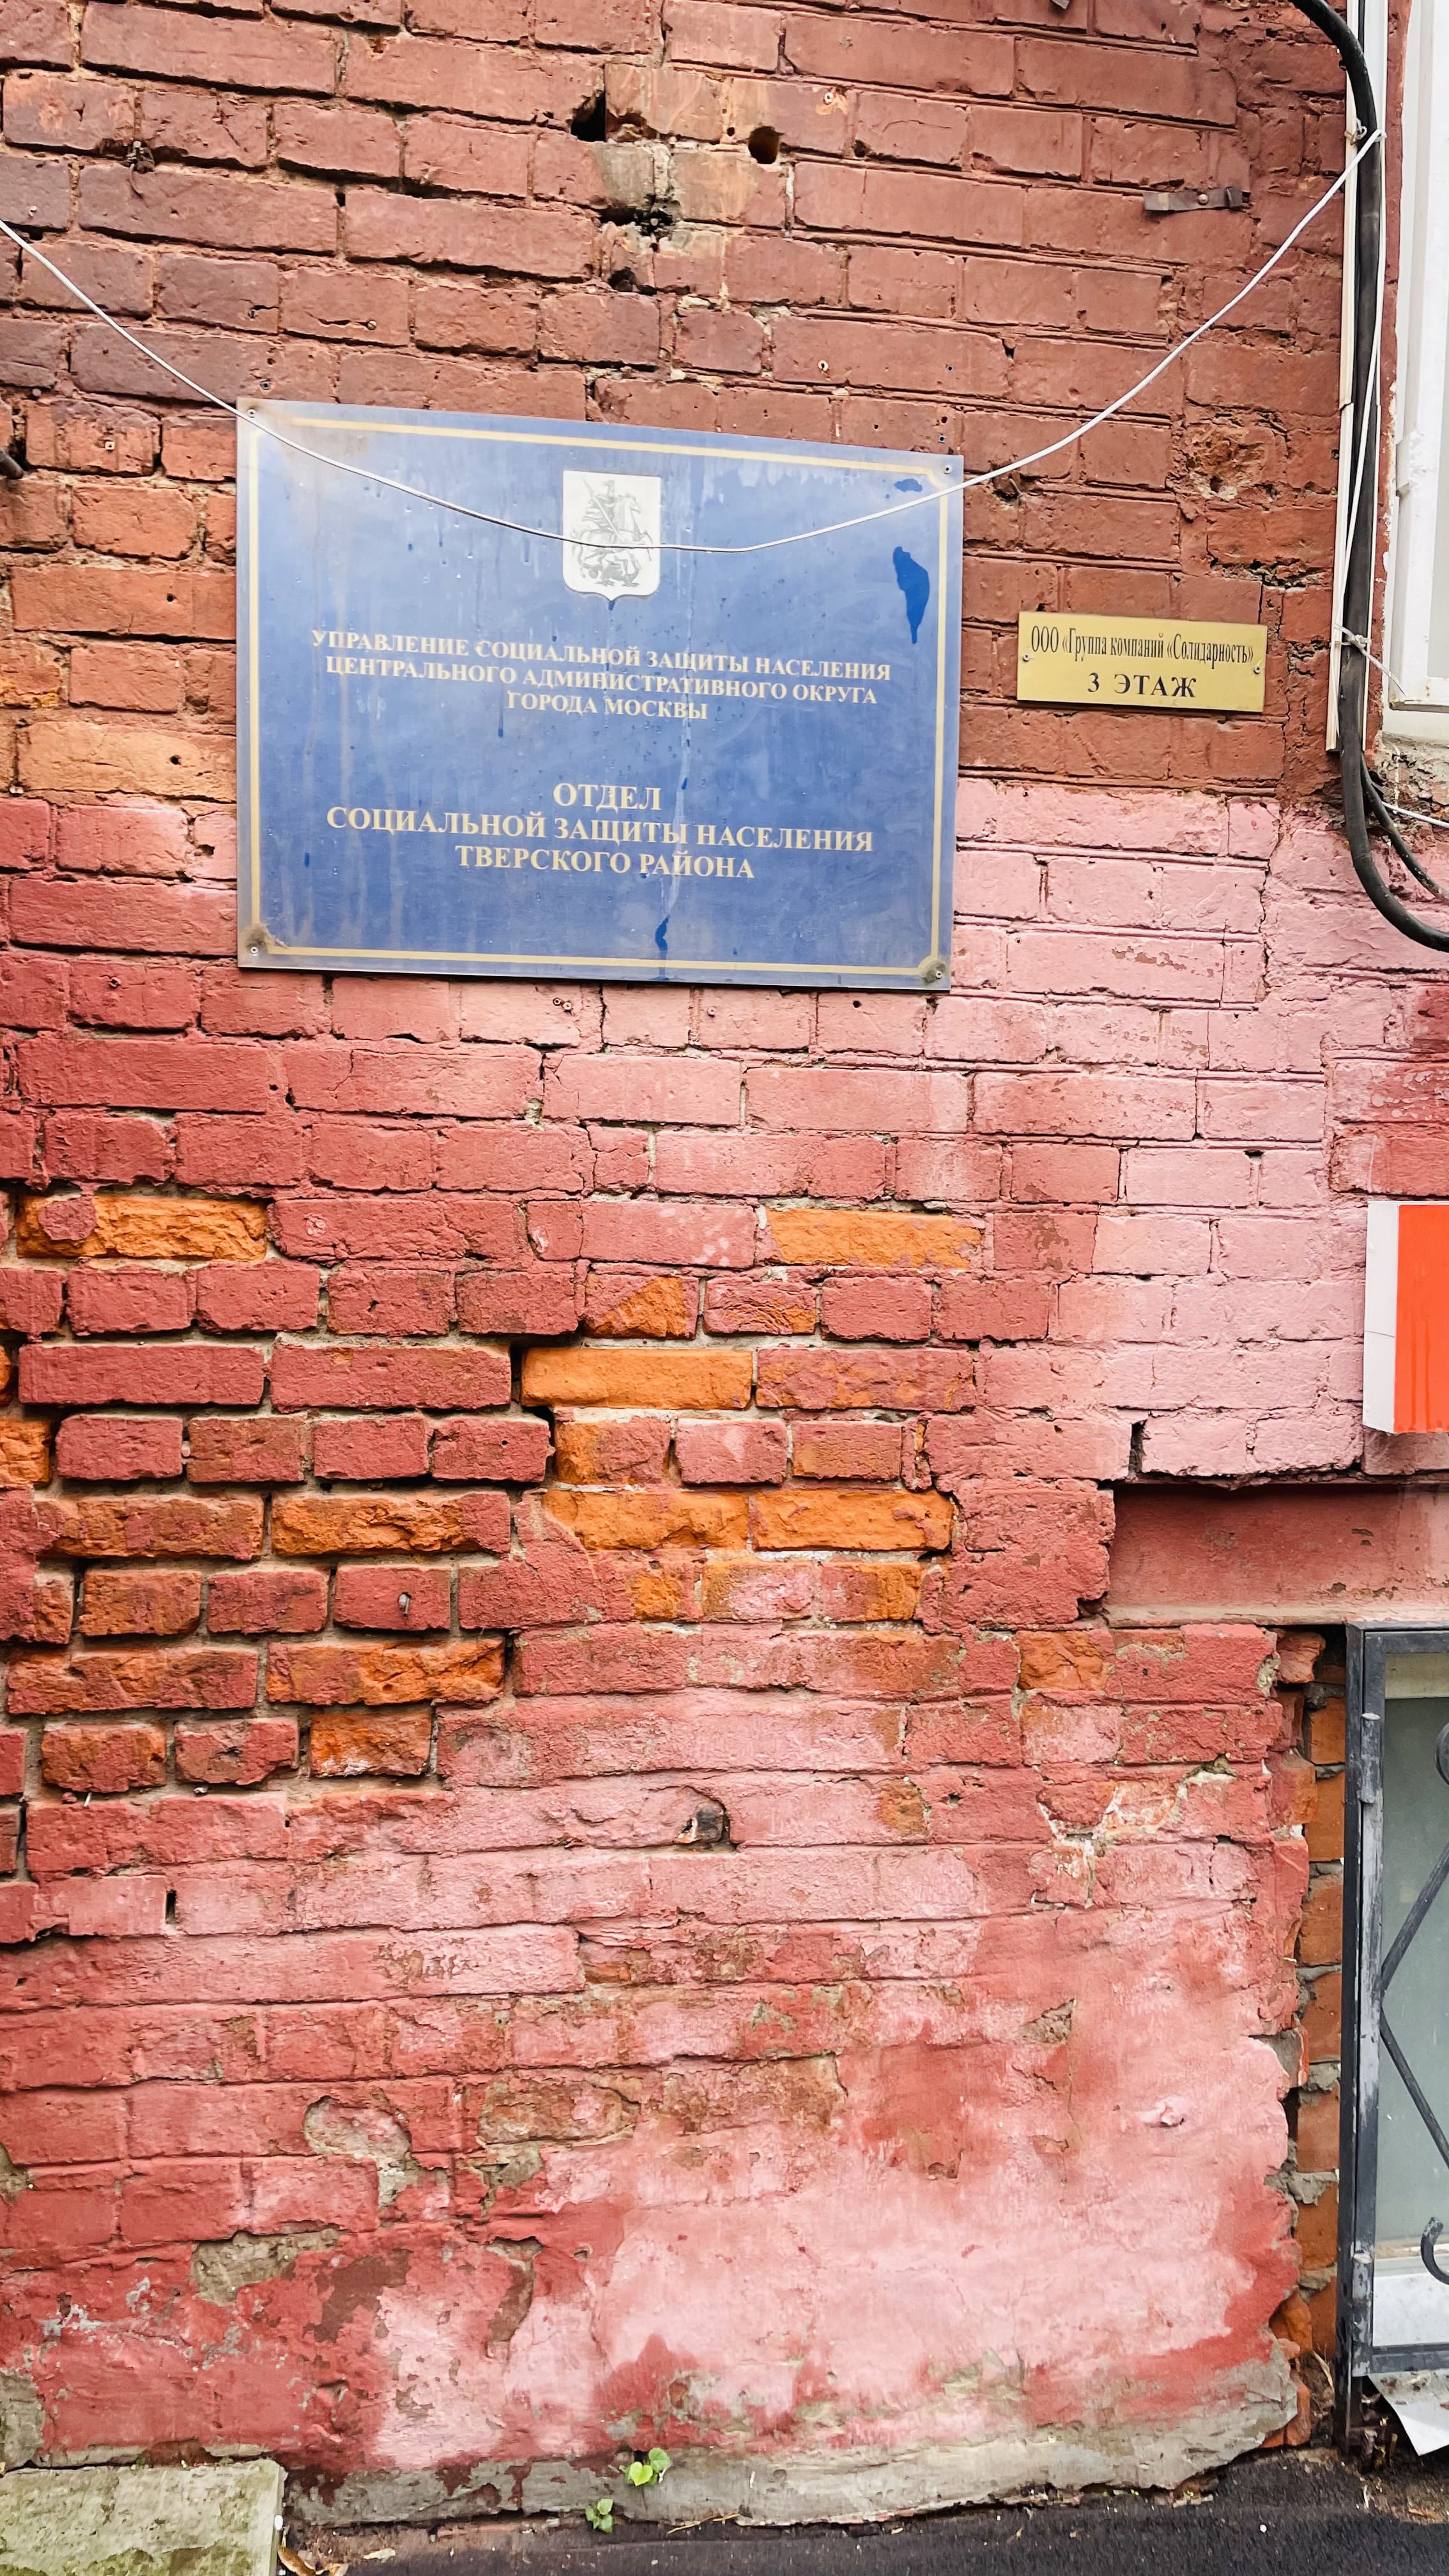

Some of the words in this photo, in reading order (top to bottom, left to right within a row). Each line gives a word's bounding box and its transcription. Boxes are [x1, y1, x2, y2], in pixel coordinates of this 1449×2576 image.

[312, 630, 469, 656] УПРАВЛЕНИЕ
[476, 640, 641, 666] СОЦИАЛЬНОЙ
[647, 651, 748, 673] ЗАЩИТЫ
[755, 657, 891, 680] НАСЕЛЕНИЯ
[1031, 625, 1059, 653] ООО
[1110, 633, 1163, 659] компаний
[326, 656, 516, 684] ЦЕНТРАЛЬНОГО
[523, 669, 787, 699] АДМИНИСТРАТИВНОГО
[792, 684, 877, 705] ОКРУГА
[1087, 673, 1100, 693] 3
[1114, 674, 1197, 698] ЭТАЖ
[507, 690, 598, 715] ГОРОДА
[604, 698, 708, 720] МОСКВЫ
[553, 783, 661, 813] ОТДЕЛ
[326, 806, 546, 838] СОЦИАЛЬНОЙ
[554, 817, 688, 846] ЗАЩИТЫ
[696, 824, 873, 852] НАСЕЛЕНИЯ
[455, 845, 631, 873] ТВЕРСКОГО
[640, 850, 755, 878] РАЙОНА
